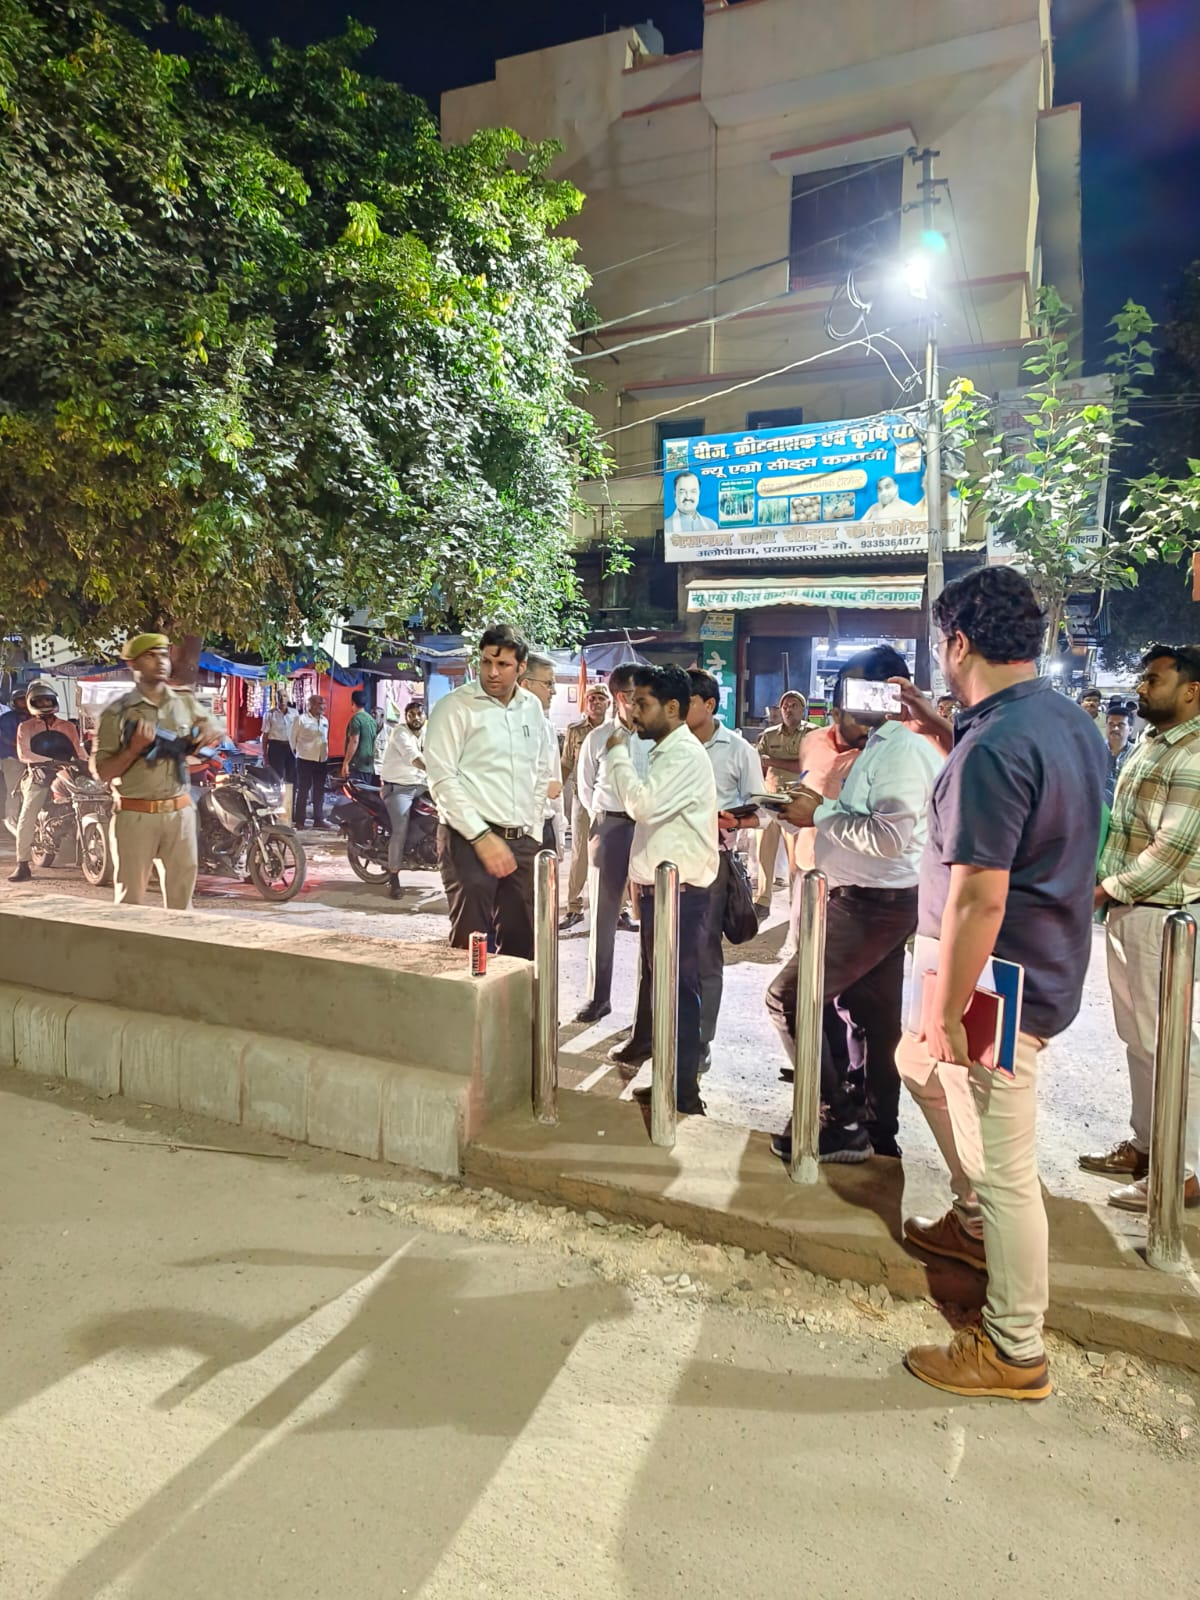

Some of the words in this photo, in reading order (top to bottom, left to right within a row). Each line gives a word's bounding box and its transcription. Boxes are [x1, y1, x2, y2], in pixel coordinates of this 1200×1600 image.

[733, 434, 819, 456] कीटनाशक
[700, 465, 727, 479] न्यू
[728, 460, 762, 475] एग्रो
[860, 590, 921, 601] कीटनाशक
